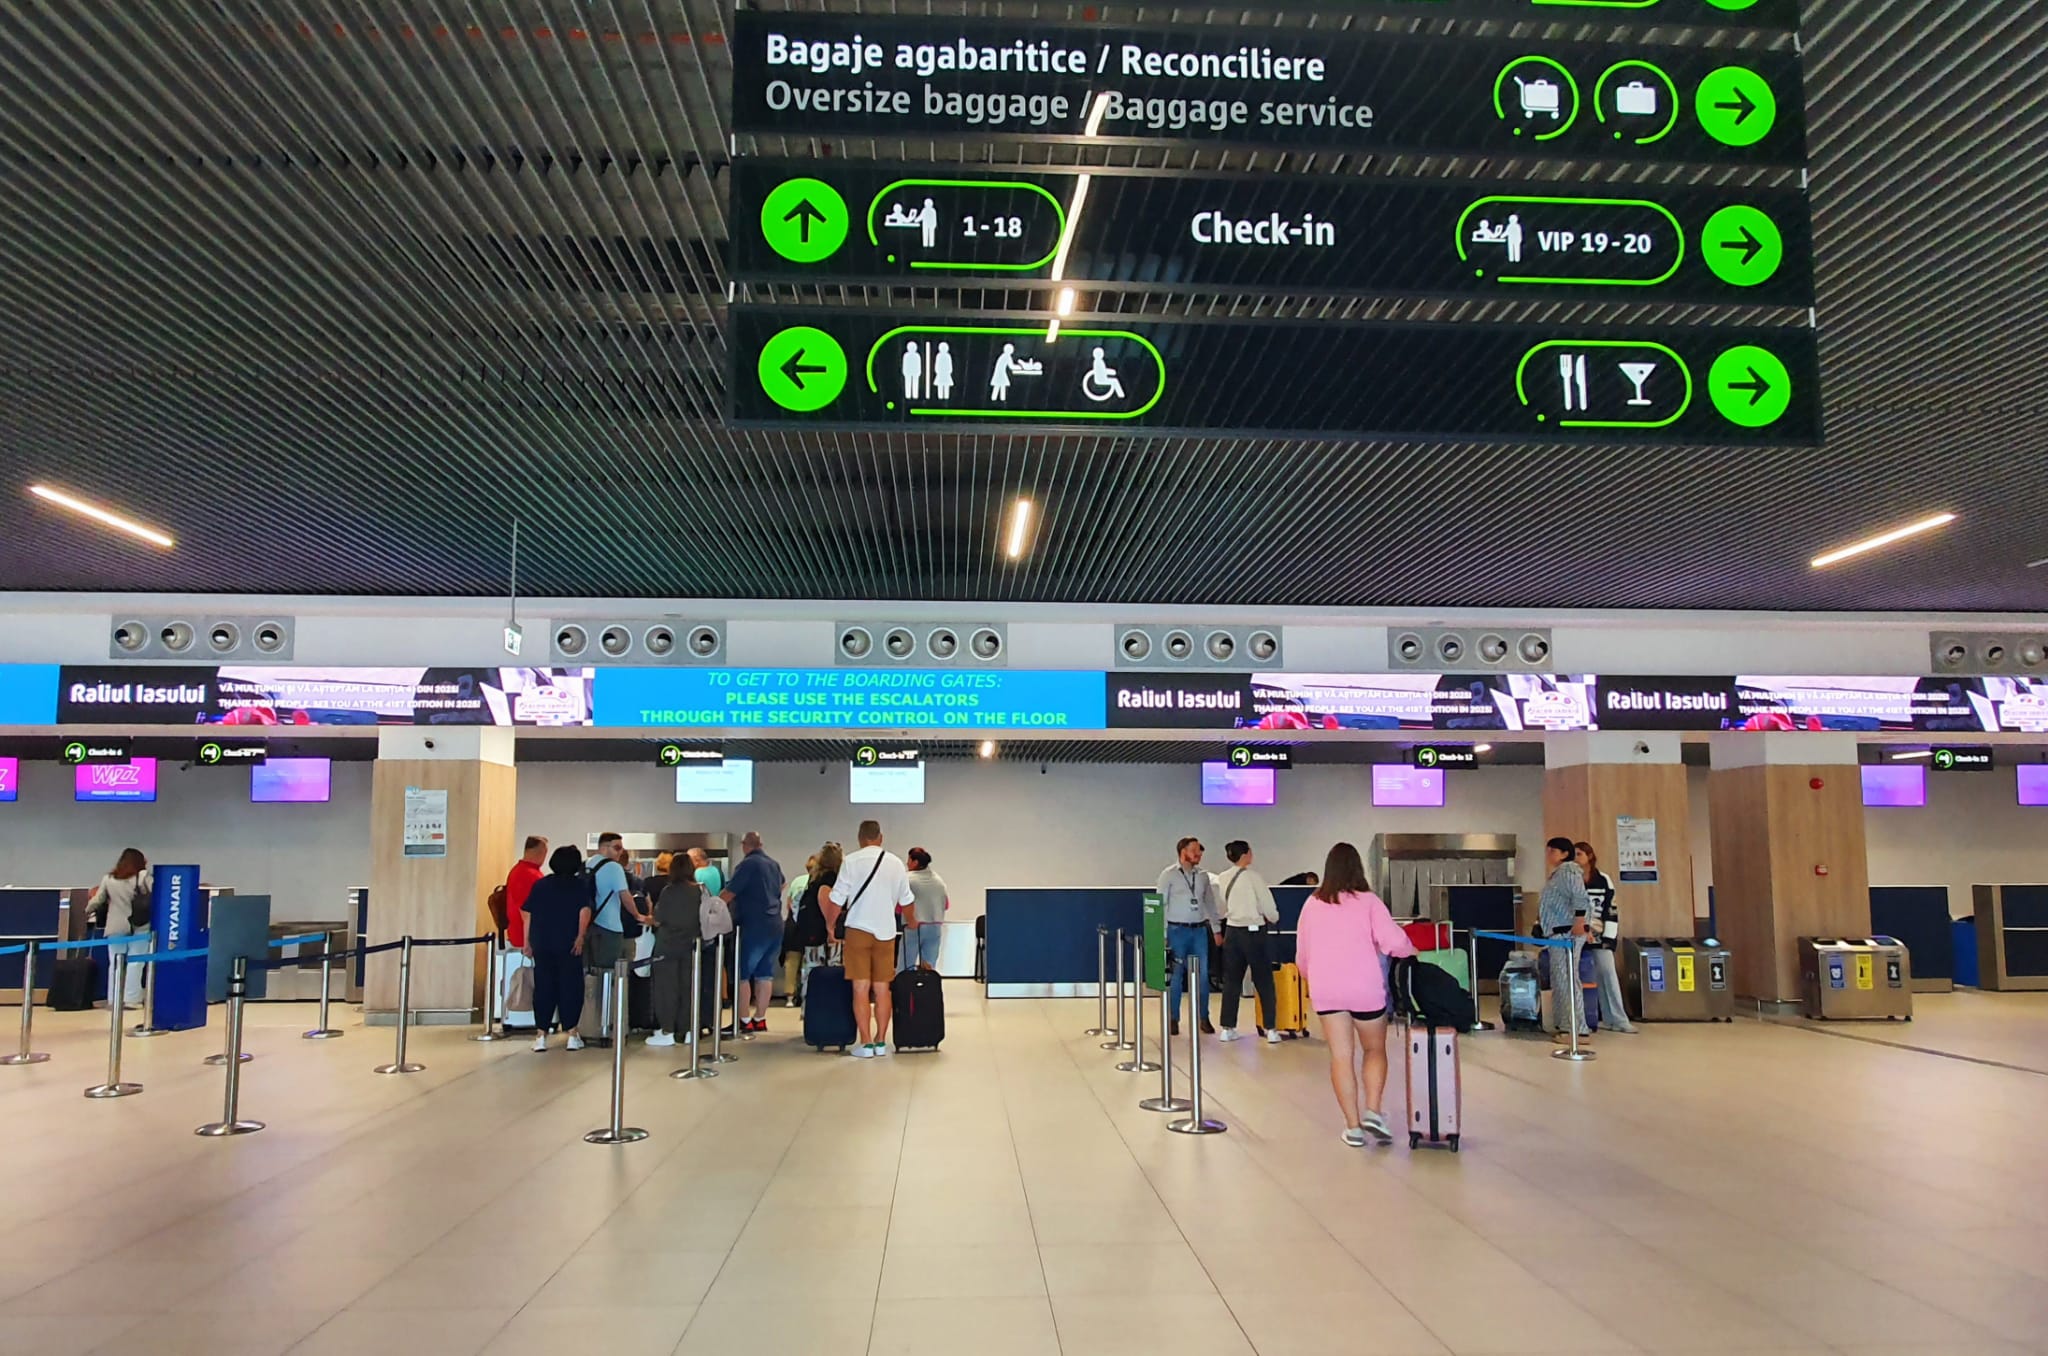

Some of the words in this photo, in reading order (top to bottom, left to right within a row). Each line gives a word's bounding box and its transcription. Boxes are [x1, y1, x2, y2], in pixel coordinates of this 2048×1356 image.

[767, 33, 883, 74] Bagaje
[895, 37, 1087, 76] agabaritice
[1096, 44, 1110, 74] /
[1122, 45, 1325, 81] Reconciliere
[766, 80, 911, 114] Oversize
[924, 83, 1068, 125] baggage
[1104, 91, 1248, 130] Baggage
[1260, 96, 1374, 128] service
[1191, 211, 1335, 246] Check-in
[1537, 231, 1575, 251] VIP
[1581, 232, 1652, 254] 19-20
[708, 672, 731, 686] TO
[736, 672, 770, 686] GET
[776, 673, 799, 686] TO
[805, 673, 839, 687] THE
[844, 673, 936, 687] BOARDING
[941, 674, 1002, 688] GATES:
[71, 683, 131, 703] Raliul
[136, 684, 205, 703] Iasului
[726, 692, 792, 705] PLEASE
[794, 693, 827, 705] USE
[832, 693, 864, 705] THE
[870, 693, 979, 706] ESCALATORS
[1118, 689, 1173, 708] Raliul
[1178, 690, 1240, 708] Iasului
[1607, 691, 1661, 709] Raliul
[1665, 691, 1727, 709] Iasului
[331, 700, 350, 708] YOU
[407, 700, 443, 708] EDITION
[445, 700, 455, 708] IN
[640, 710, 724, 723] THROUGH
[729, 710, 763, 723] THE
[768, 711, 853, 723] SECURITY
[858, 711, 938, 724] CONTROL
[944, 712, 969, 724] ON
[974, 712, 1006, 724] THE
[1012, 712, 1067, 725] FLOOR
[168, 874, 182, 941] RYANAIR
